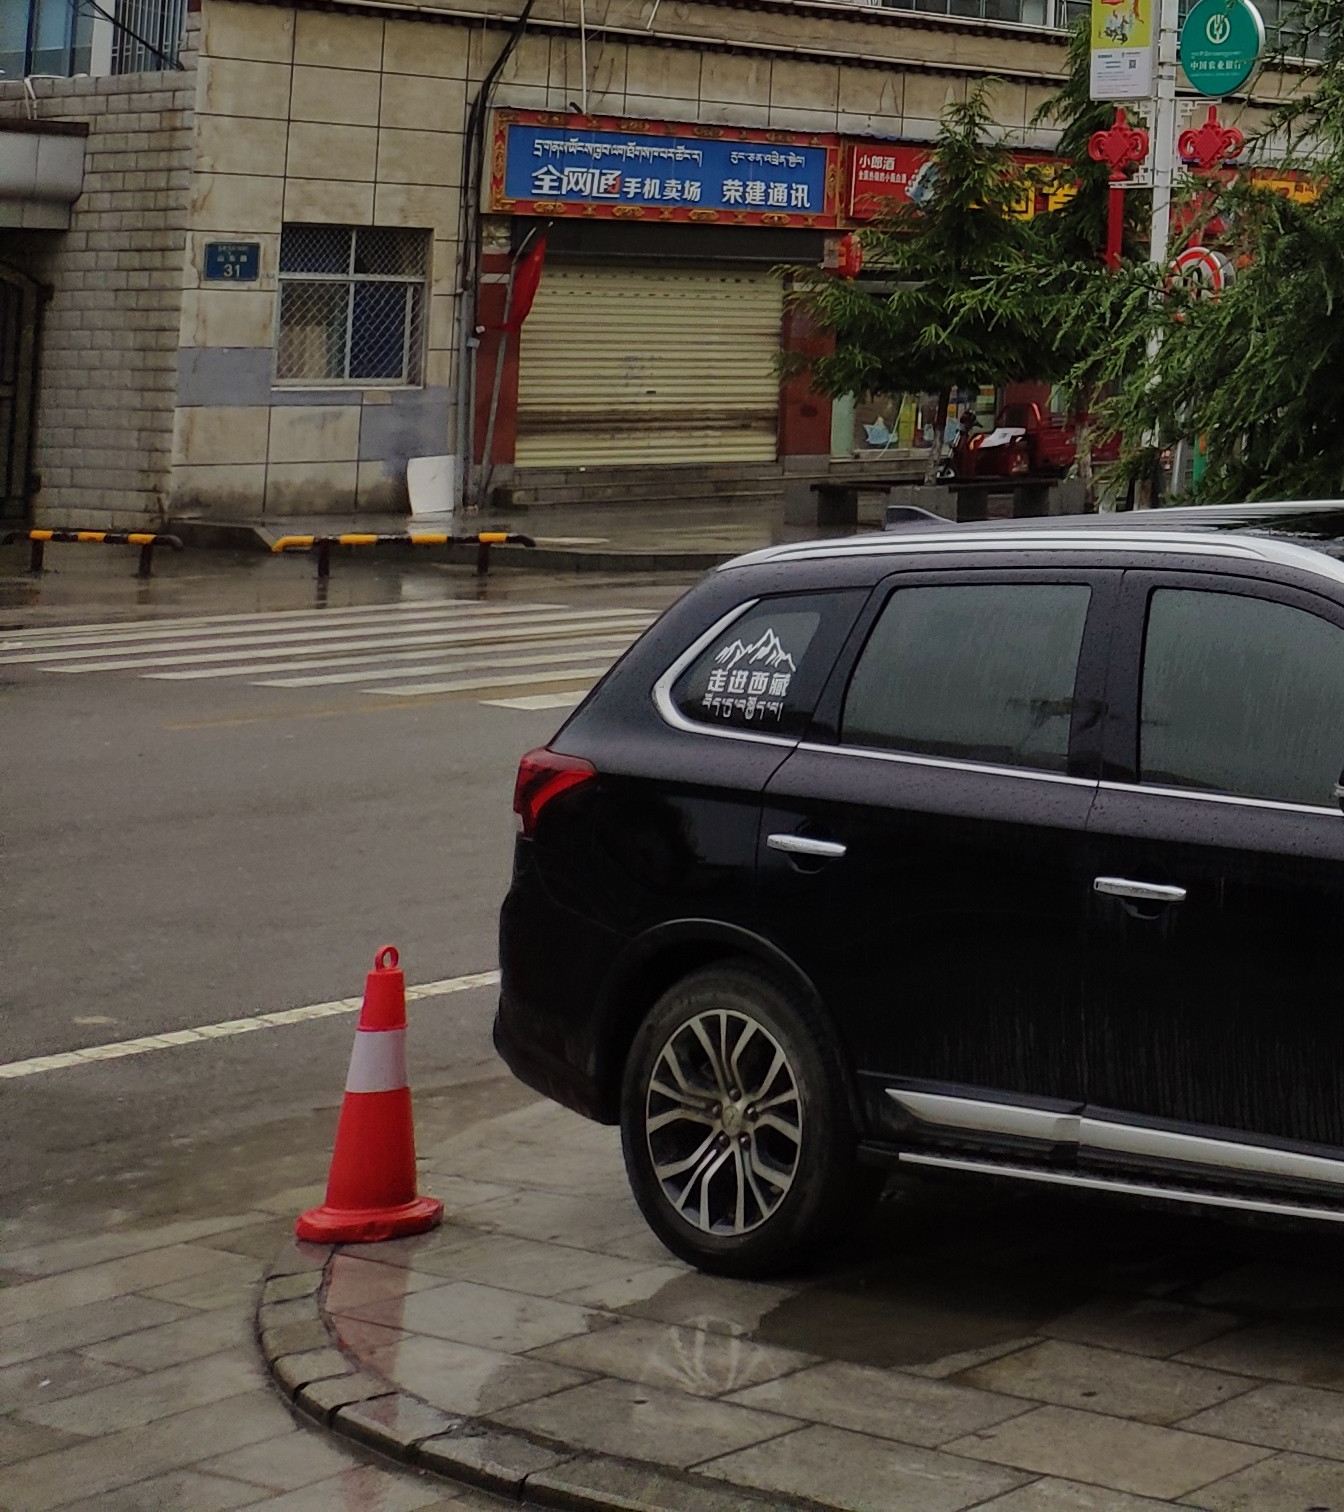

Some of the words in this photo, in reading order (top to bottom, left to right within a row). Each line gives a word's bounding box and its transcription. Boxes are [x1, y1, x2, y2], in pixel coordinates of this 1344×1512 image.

[859, 154, 895, 171] 小郎酒
[722, 179, 811, 208] 荣建通讯
[223, 263, 241, 278] 31
[707, 668, 791, 697] 走进西藏
